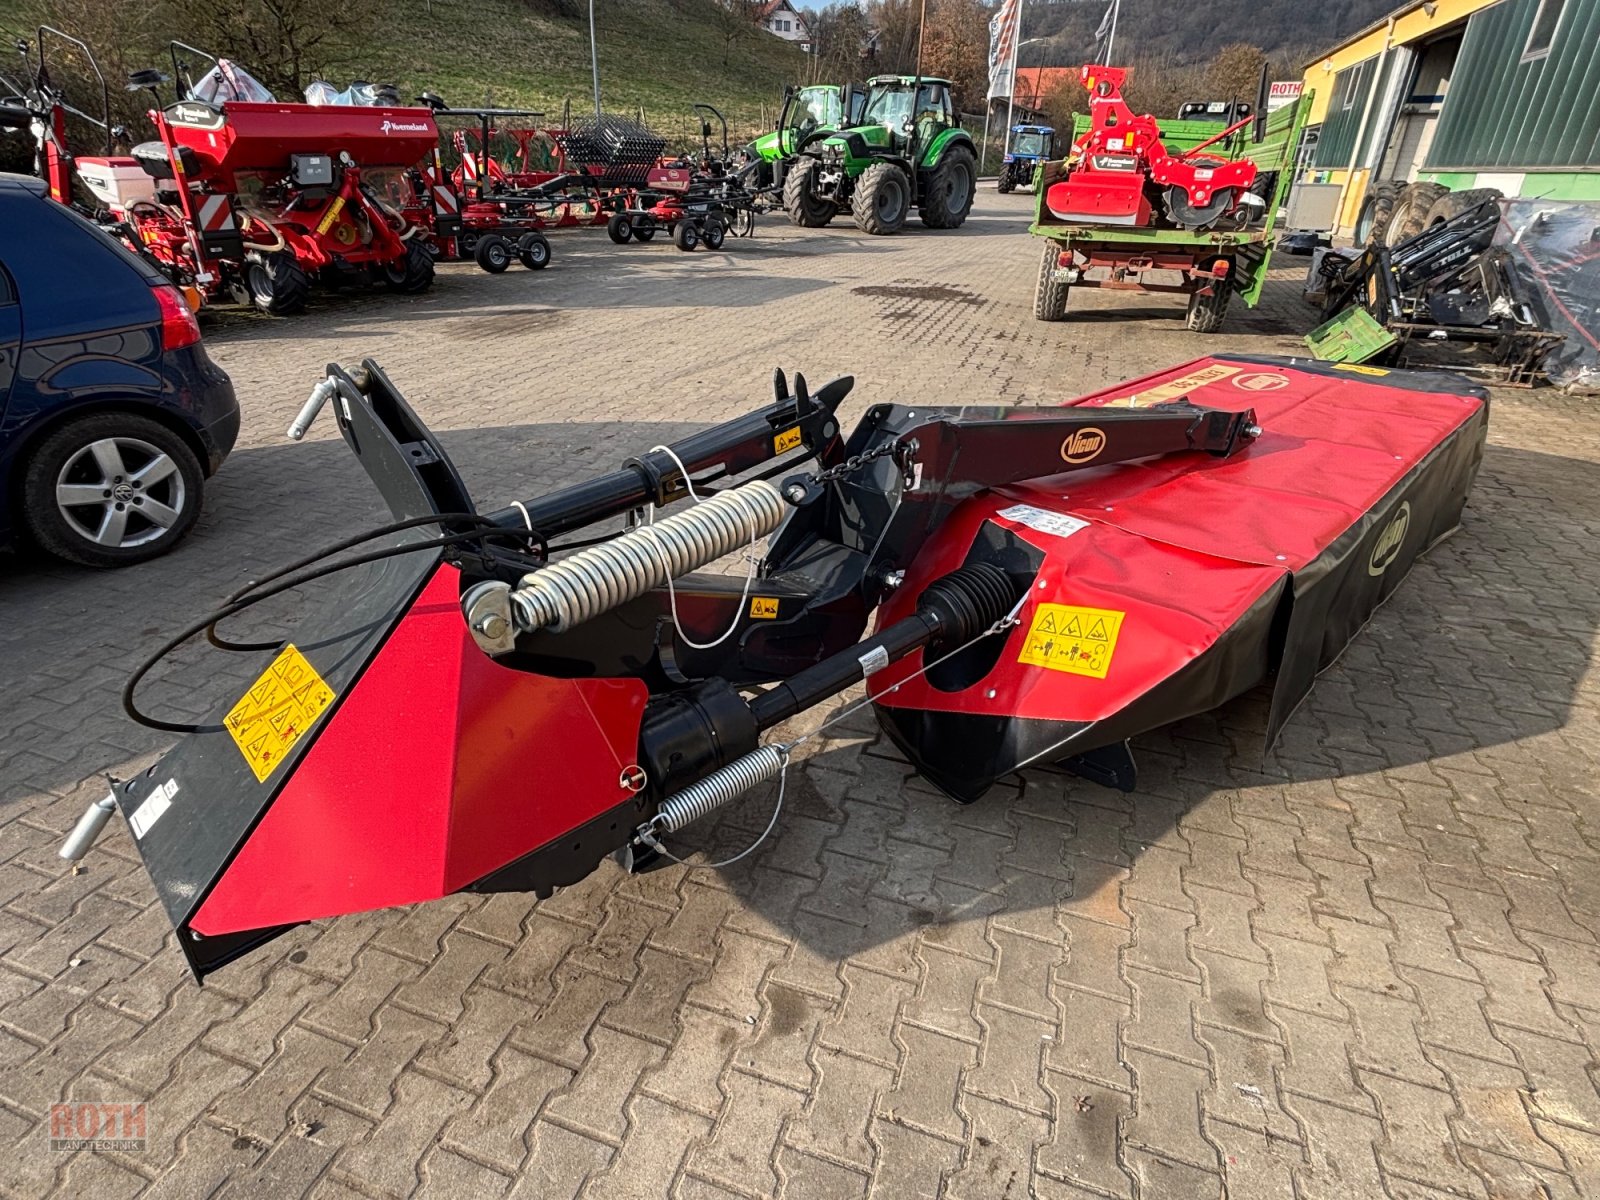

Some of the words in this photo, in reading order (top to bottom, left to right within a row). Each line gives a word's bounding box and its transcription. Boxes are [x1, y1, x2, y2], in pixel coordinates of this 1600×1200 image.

[1271, 83, 1301, 95] ROTH
[1430, 245, 1473, 270] STOLL
[1064, 430, 1103, 459] Vicon
